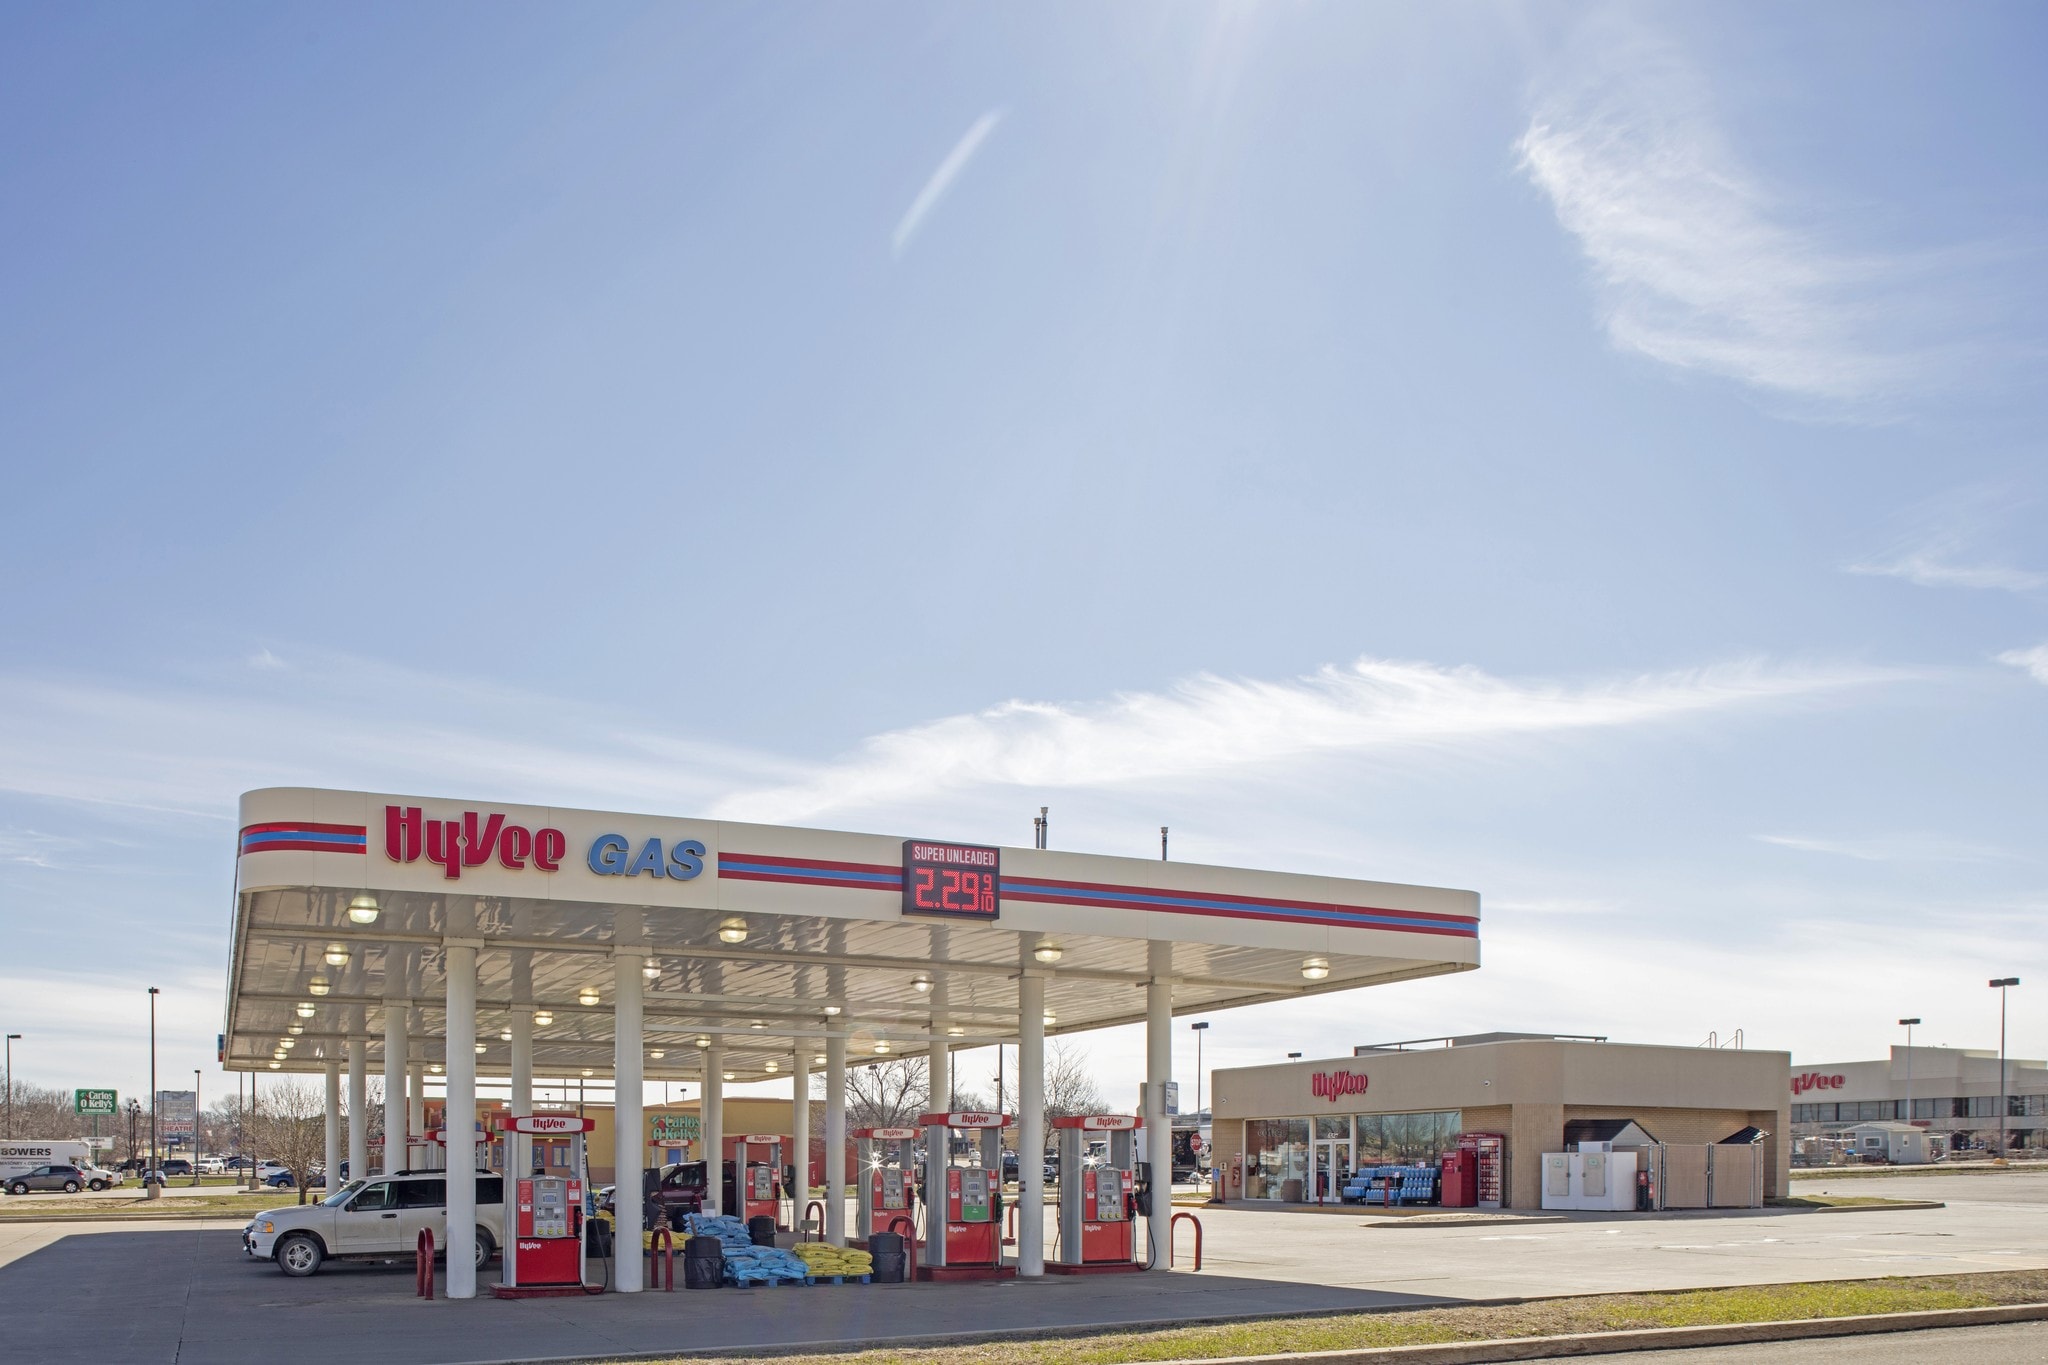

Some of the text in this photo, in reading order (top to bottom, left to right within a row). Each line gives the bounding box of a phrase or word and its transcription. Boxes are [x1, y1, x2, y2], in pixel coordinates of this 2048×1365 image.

[385, 805, 707, 881] HyVee GAS
[914, 846, 995, 866] SUPER UNLEADED
[915, 868, 979, 911] 2.29
[1312, 1071, 1368, 1102] HyVee
[1791, 1073, 1845, 1095] yVee
[532, 1118, 566, 1130] HyVee
[961, 1114, 989, 1125] HyVee
[1096, 1117, 1122, 1127] HyVee
[1, 1147, 52, 1156] BOWERS
